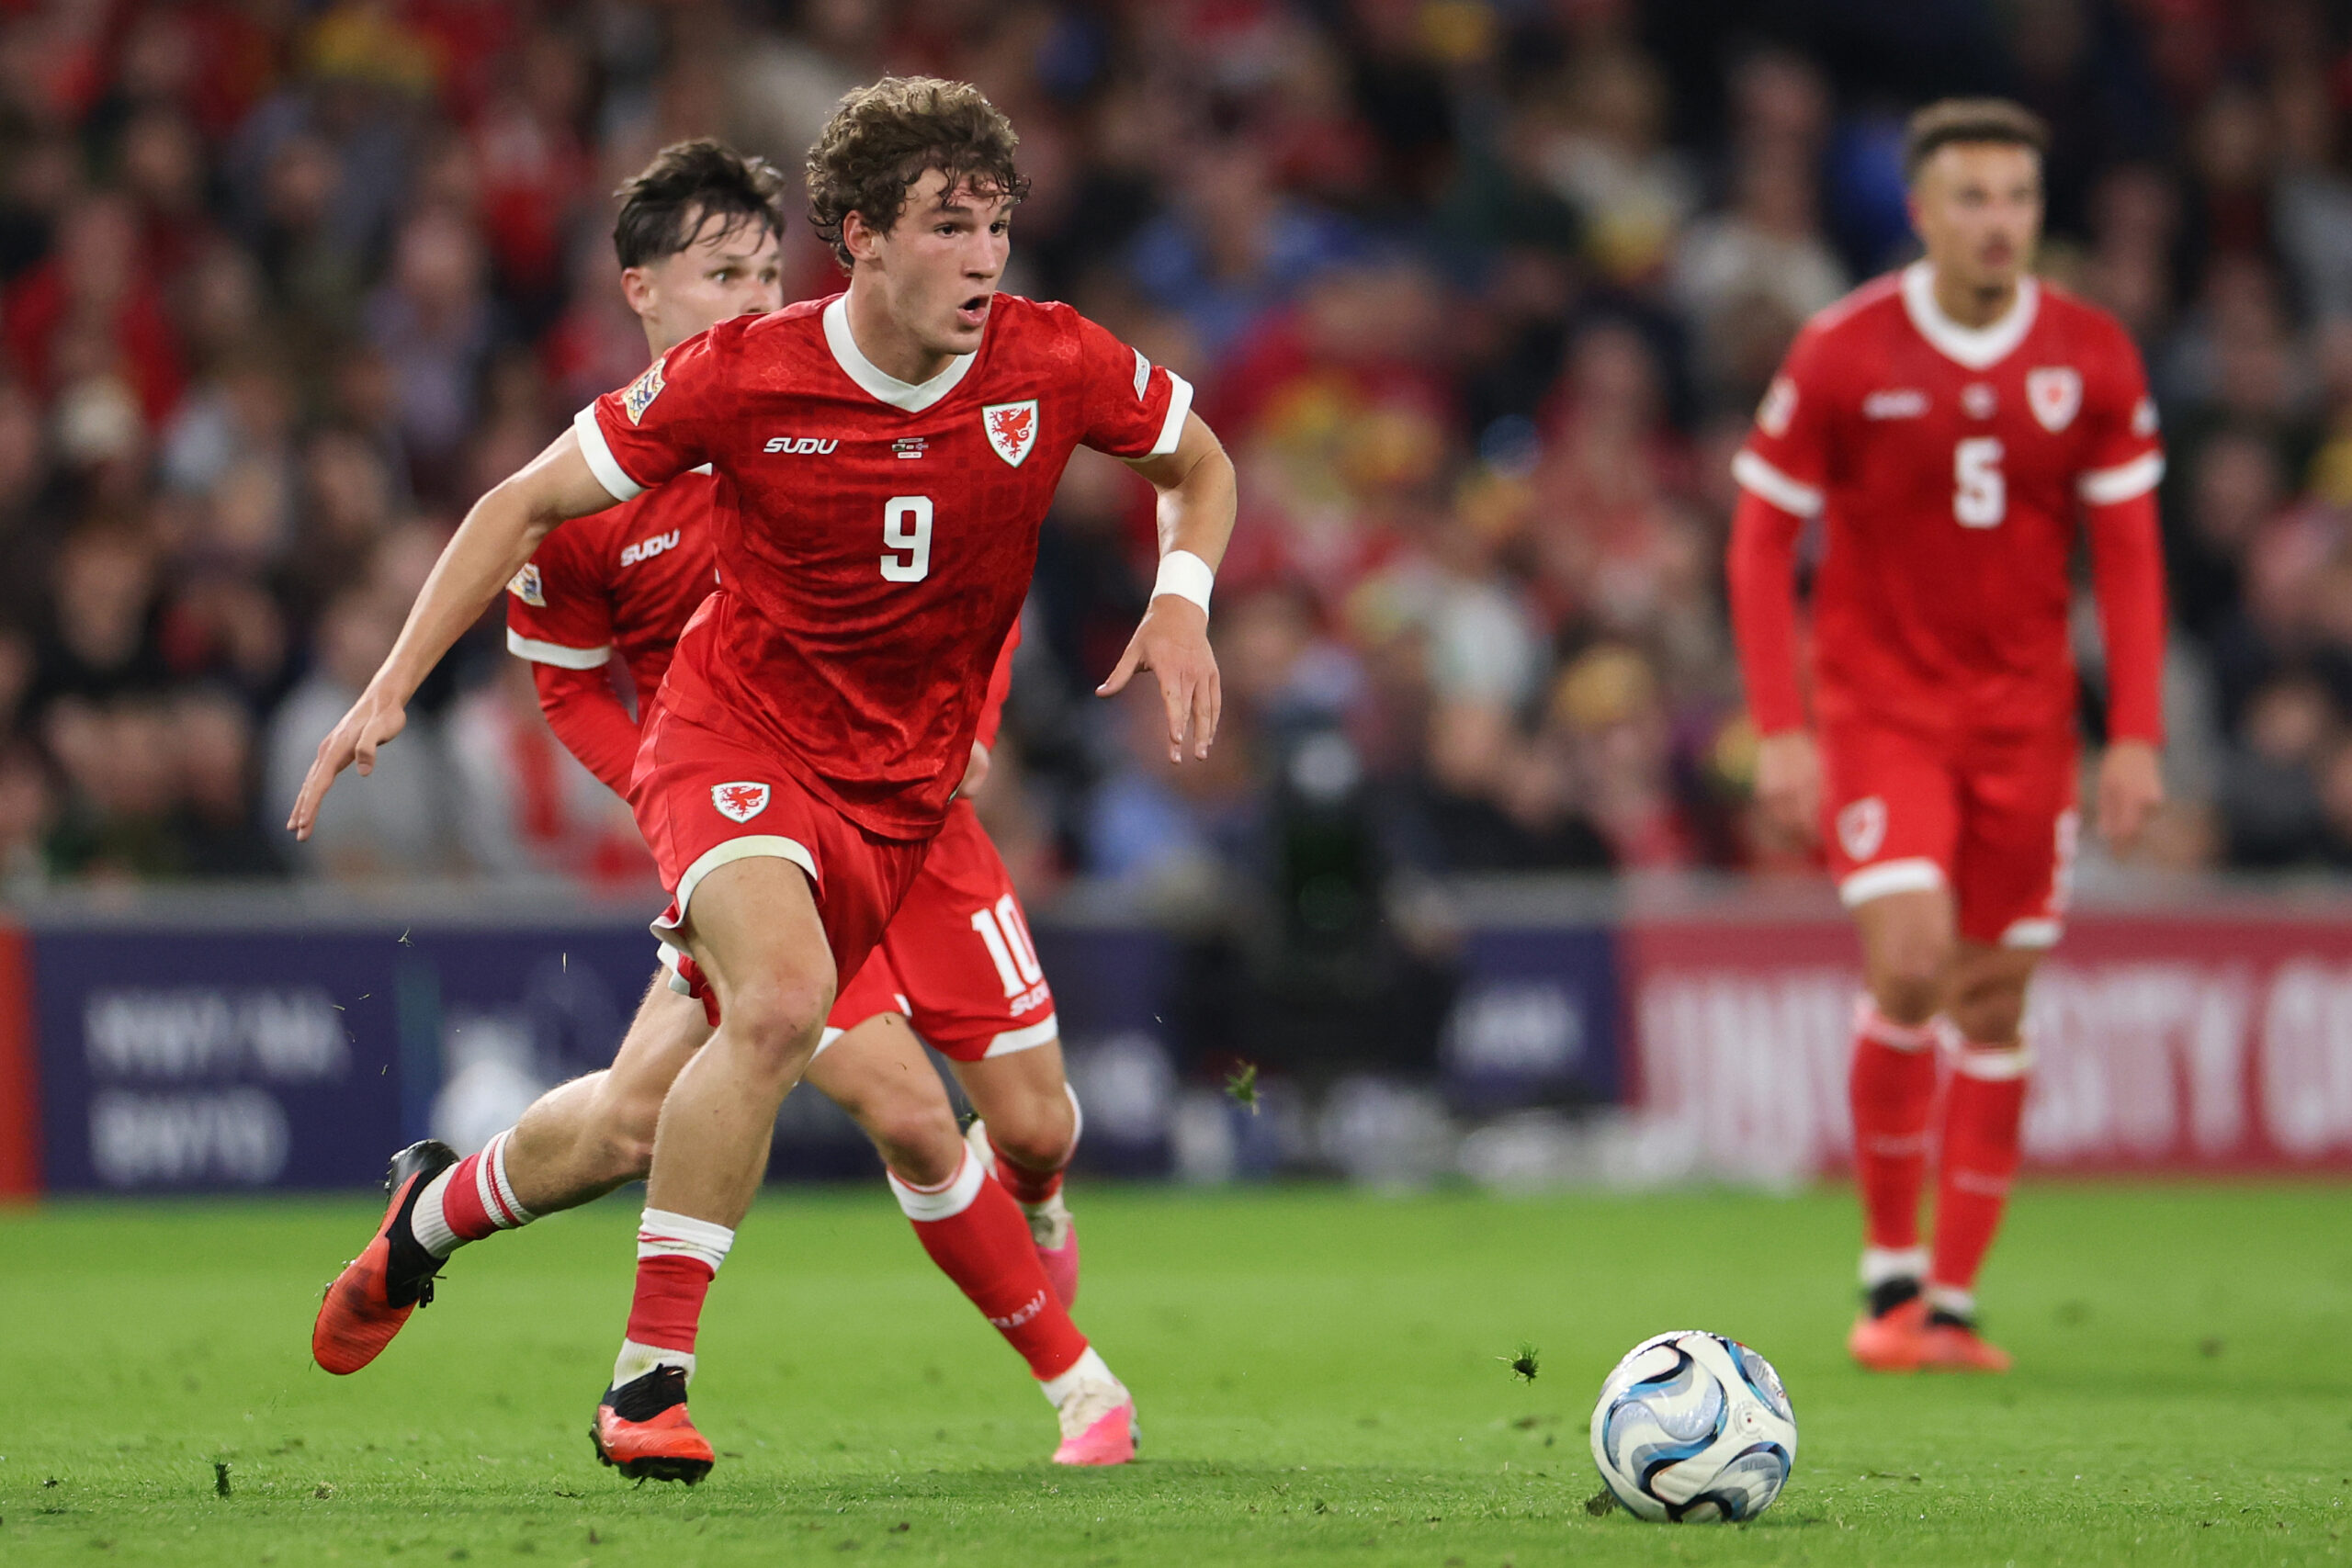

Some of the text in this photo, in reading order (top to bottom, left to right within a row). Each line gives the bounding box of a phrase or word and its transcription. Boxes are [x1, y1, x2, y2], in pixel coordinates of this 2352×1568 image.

[763, 436, 839, 455] SUDU
[1952, 436, 2007, 529] 5
[620, 527, 681, 568] SUDU
[879, 495, 933, 583] 9
[970, 893, 1044, 998] 10
